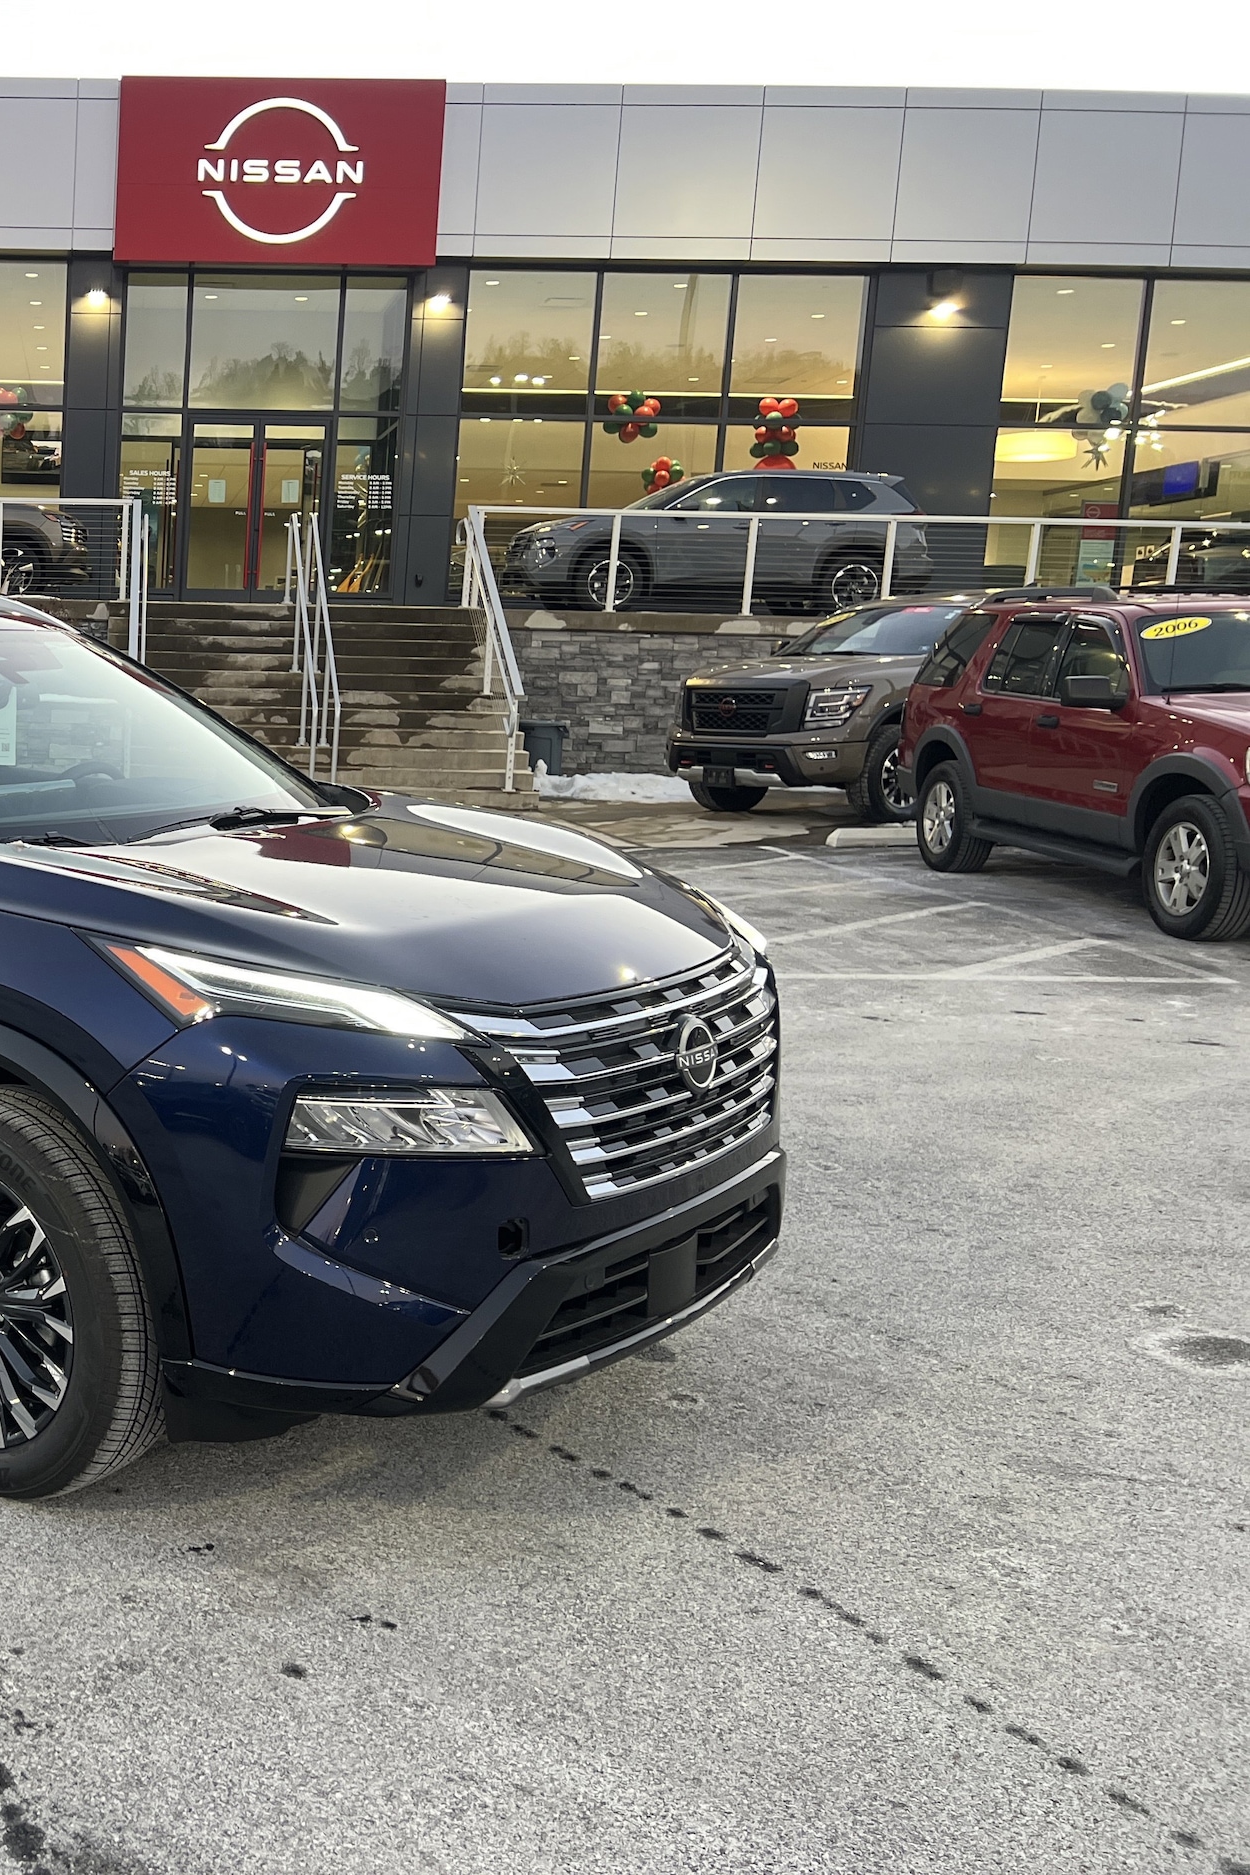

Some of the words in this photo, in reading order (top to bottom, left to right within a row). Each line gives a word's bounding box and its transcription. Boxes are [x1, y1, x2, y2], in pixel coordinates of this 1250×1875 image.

[197, 158, 364, 184] NISSAN
[812, 461, 847, 470] NISSAN
[1153, 618, 1198, 637] 2006
